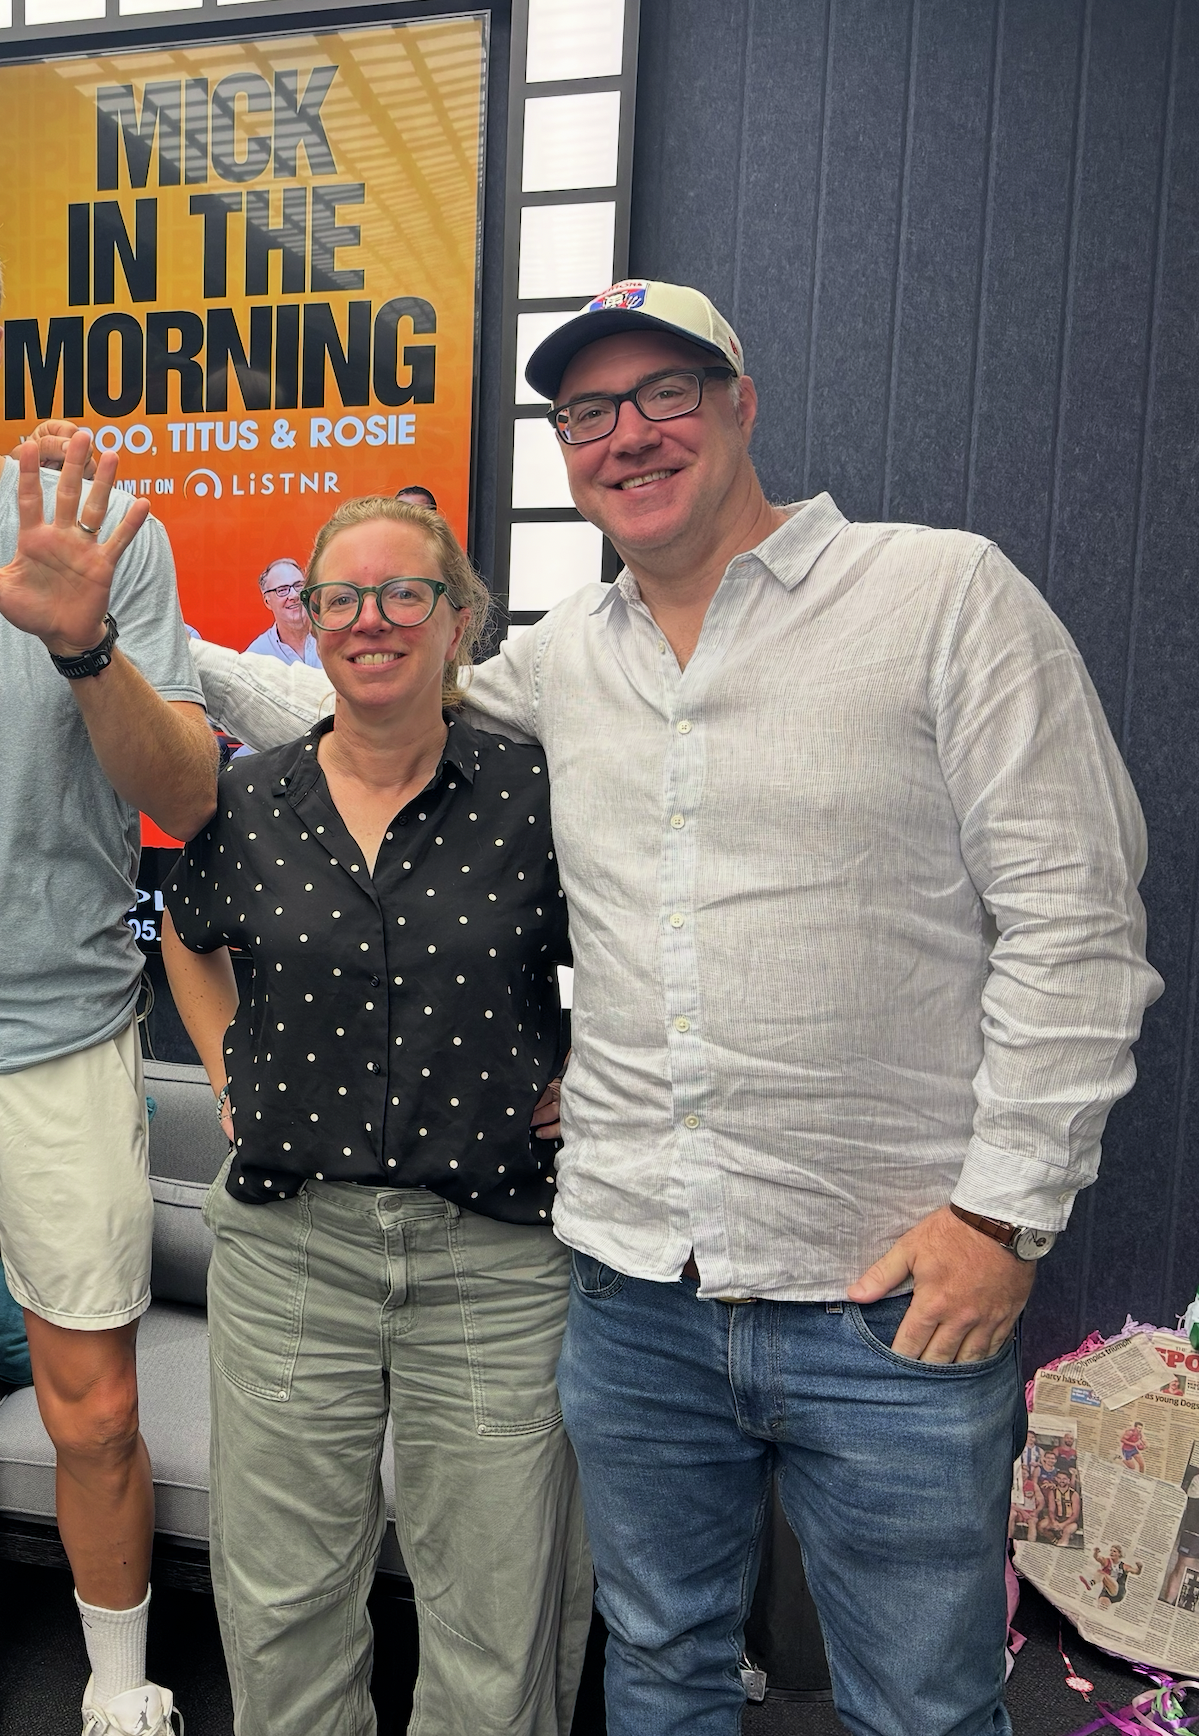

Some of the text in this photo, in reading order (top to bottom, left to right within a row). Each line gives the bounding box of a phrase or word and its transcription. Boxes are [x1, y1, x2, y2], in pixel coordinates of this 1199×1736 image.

[96, 65, 339, 192] MICK
[68, 197, 157, 307] IN
[189, 182, 366, 299] THE
[4, 296, 438, 420] MORNING
[167, 419, 259, 453] TITUS
[270, 418, 297, 450] &
[310, 414, 416, 448] ROSIE
[140, 478, 152, 495] IT
[155, 478, 174, 495] ON
[232, 471, 341, 496] LiSTNR
[1076, 1351, 1106, 1368] Olympics
[1105, 1338, 1133, 1355] triumph
[1040, 1371, 1062, 1382] Darcy
[1062, 1374, 1076, 1384] has
[1155, 1394, 1179, 1406] young
